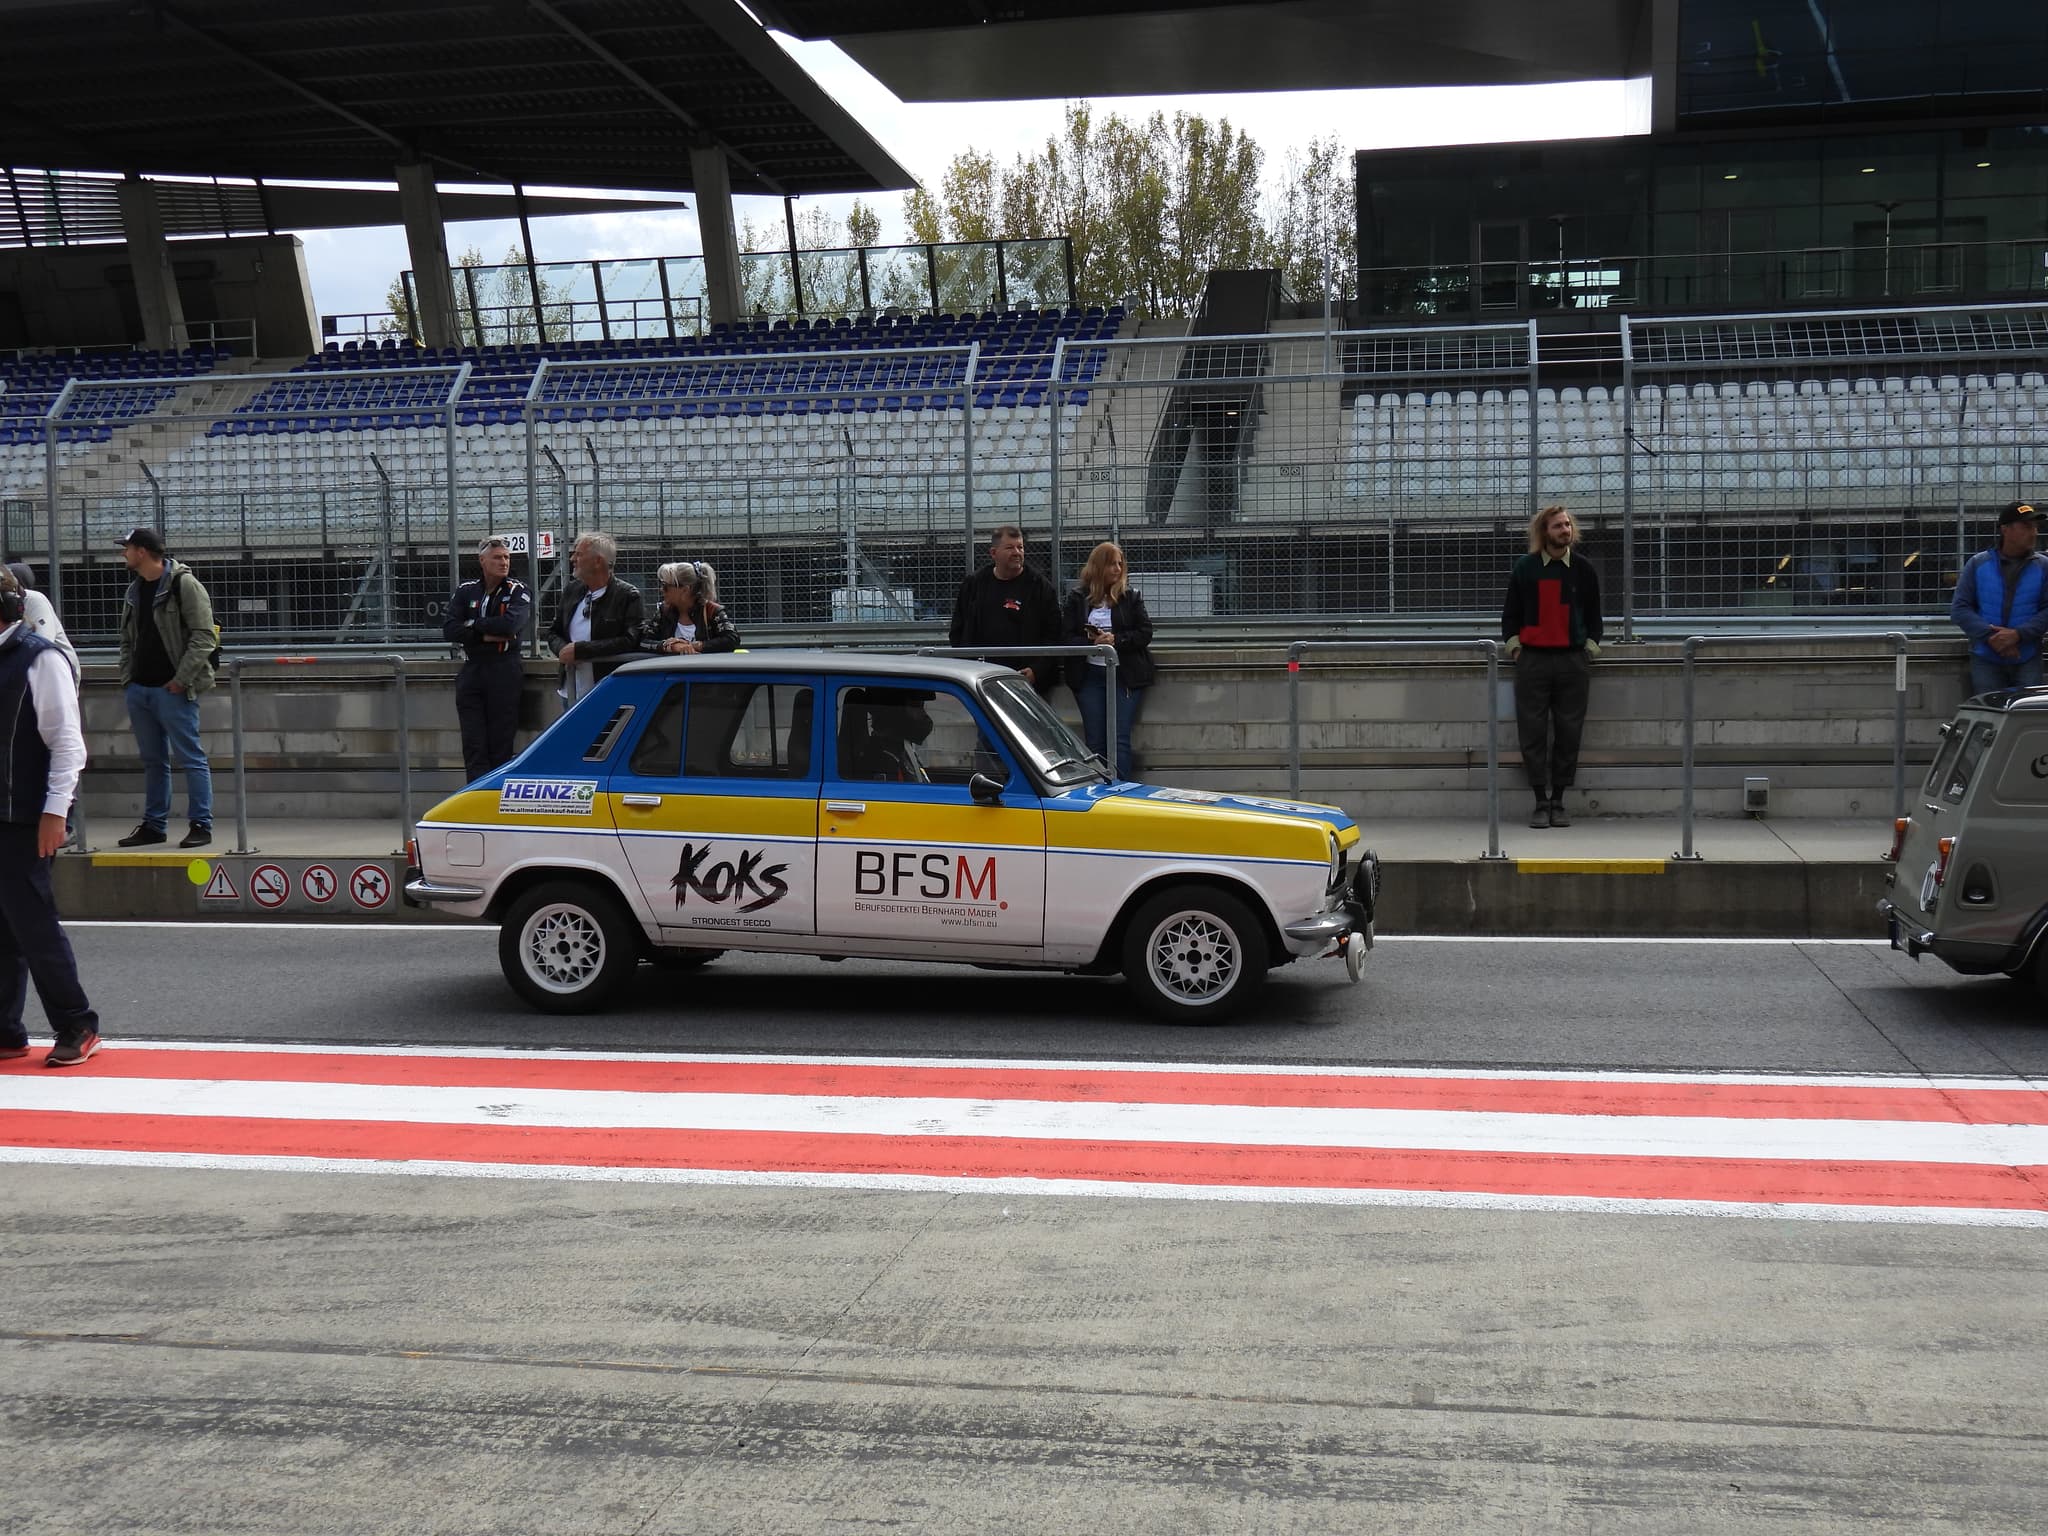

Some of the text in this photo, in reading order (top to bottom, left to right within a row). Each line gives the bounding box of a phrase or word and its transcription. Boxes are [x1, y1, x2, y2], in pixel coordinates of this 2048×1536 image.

[511, 536, 526, 551] 28
[504, 783, 574, 800] HEINZ
[854, 902, 997, 919] BERUFSDETEKTEI BERNHARD MADER
[691, 917, 771, 928] STRONGEST SECCO
[941, 917, 998, 928] www.bfsm.eu
